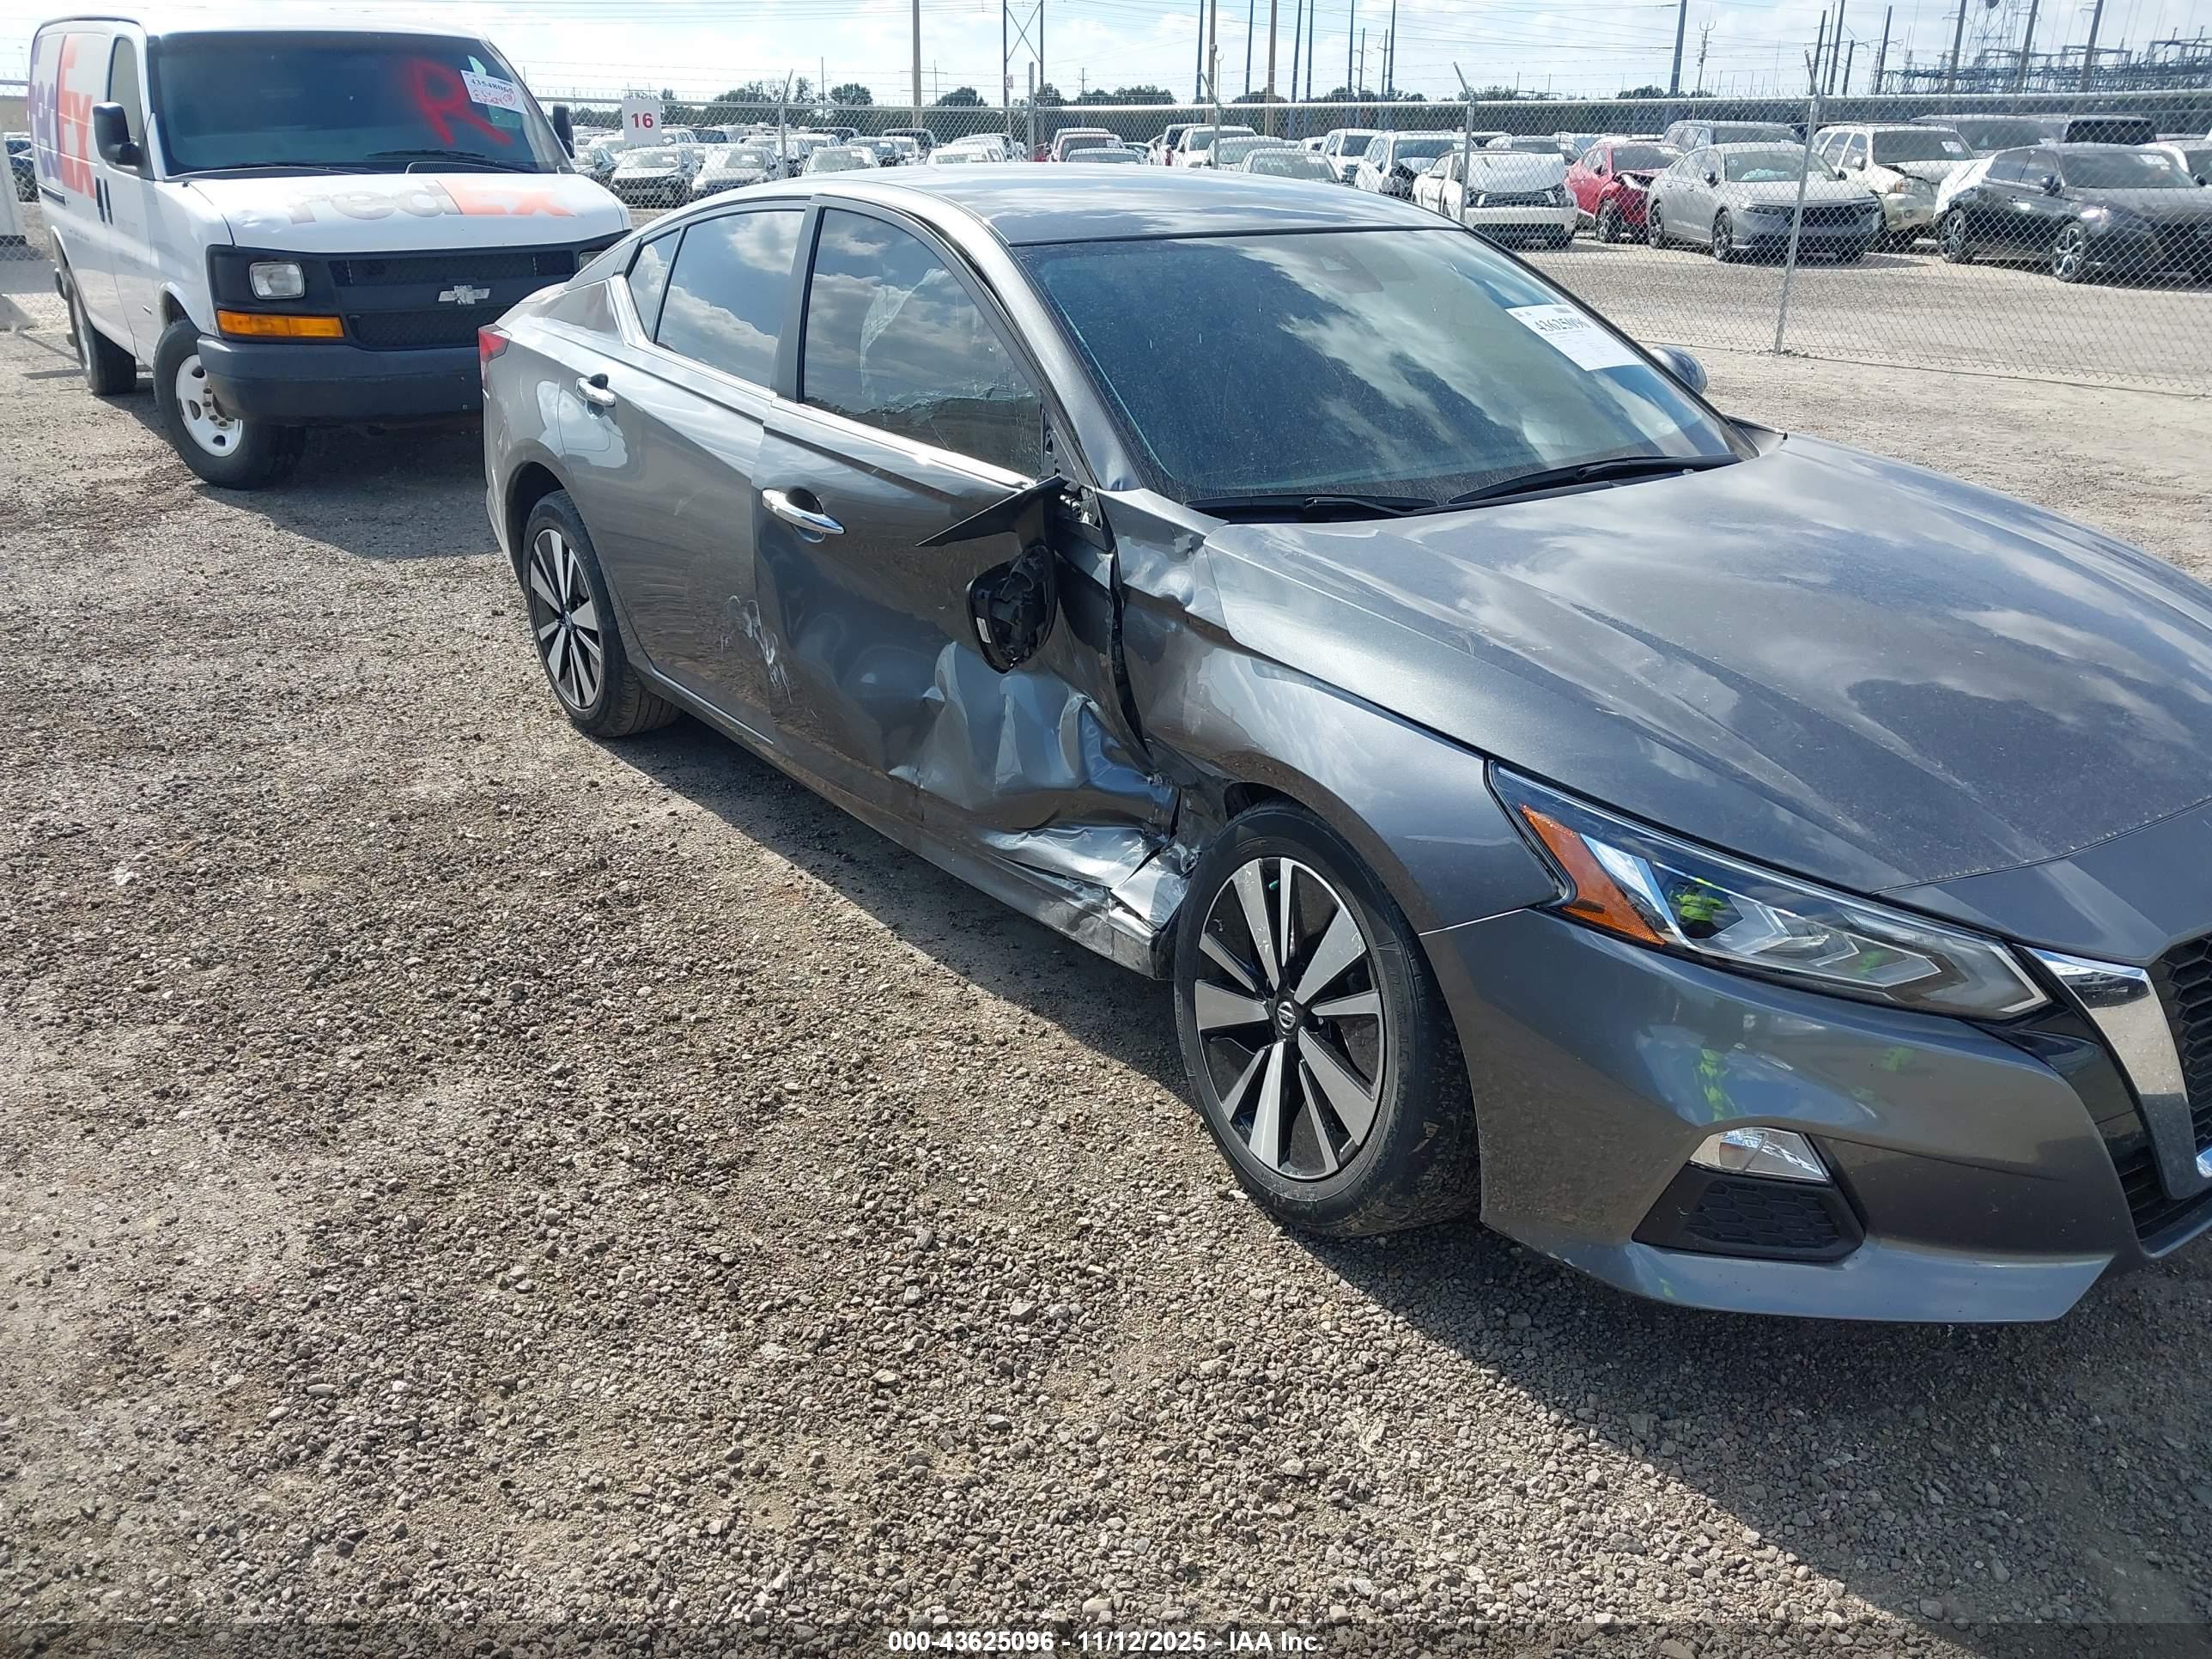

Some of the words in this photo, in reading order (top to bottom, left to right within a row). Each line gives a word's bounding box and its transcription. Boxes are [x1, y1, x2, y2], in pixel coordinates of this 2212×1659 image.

[408, 57, 514, 147] R
[631, 112, 653, 129] 16
[1534, 317, 1590, 331] 43625096
